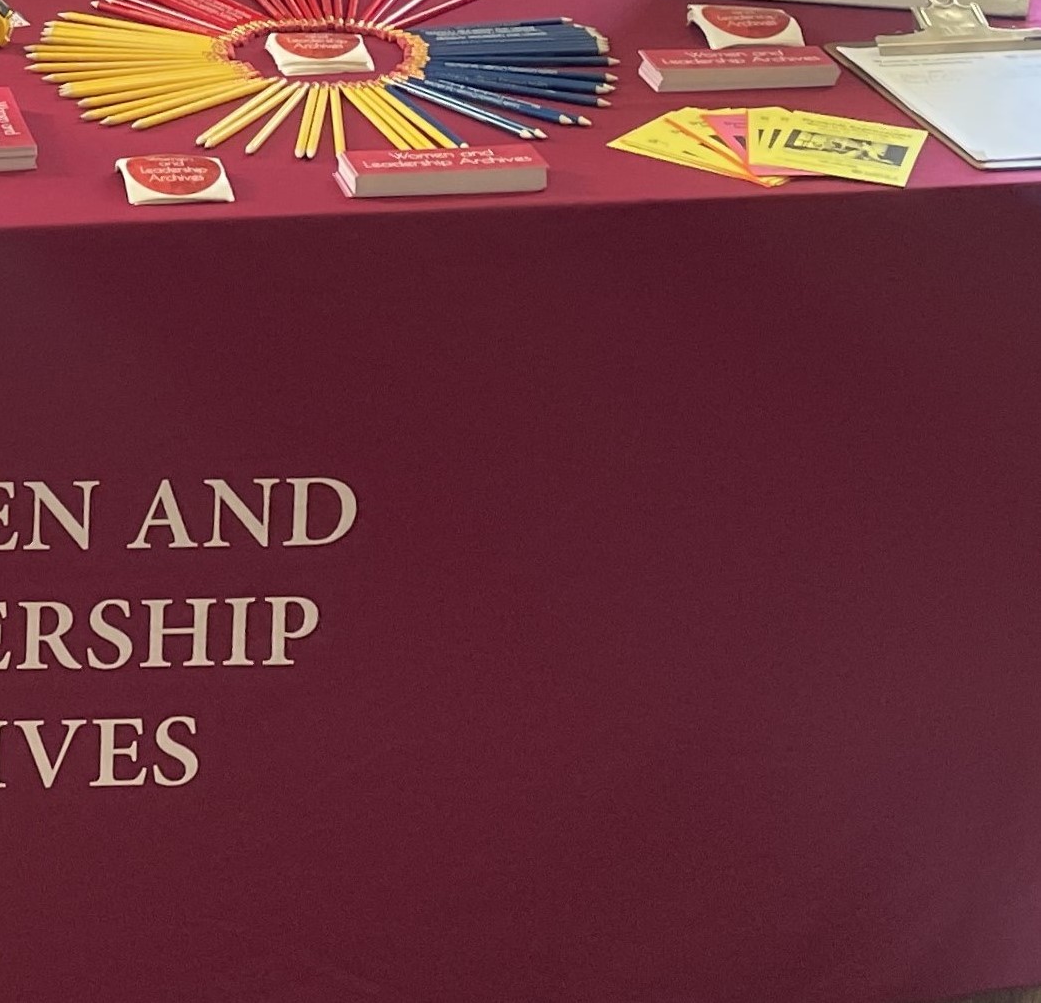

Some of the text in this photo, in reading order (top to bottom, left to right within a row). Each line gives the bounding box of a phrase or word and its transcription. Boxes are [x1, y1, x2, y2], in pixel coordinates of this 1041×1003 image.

[752, 49, 784, 57] and
[661, 54, 820, 65] Leadership Archives
[388, 149, 494, 160] Women and
[363, 155, 532, 169] Leadership Archives
[140, 166, 208, 174] Leadership
[149, 174, 205, 182] Archives
[127, 476, 358, 549] AND
